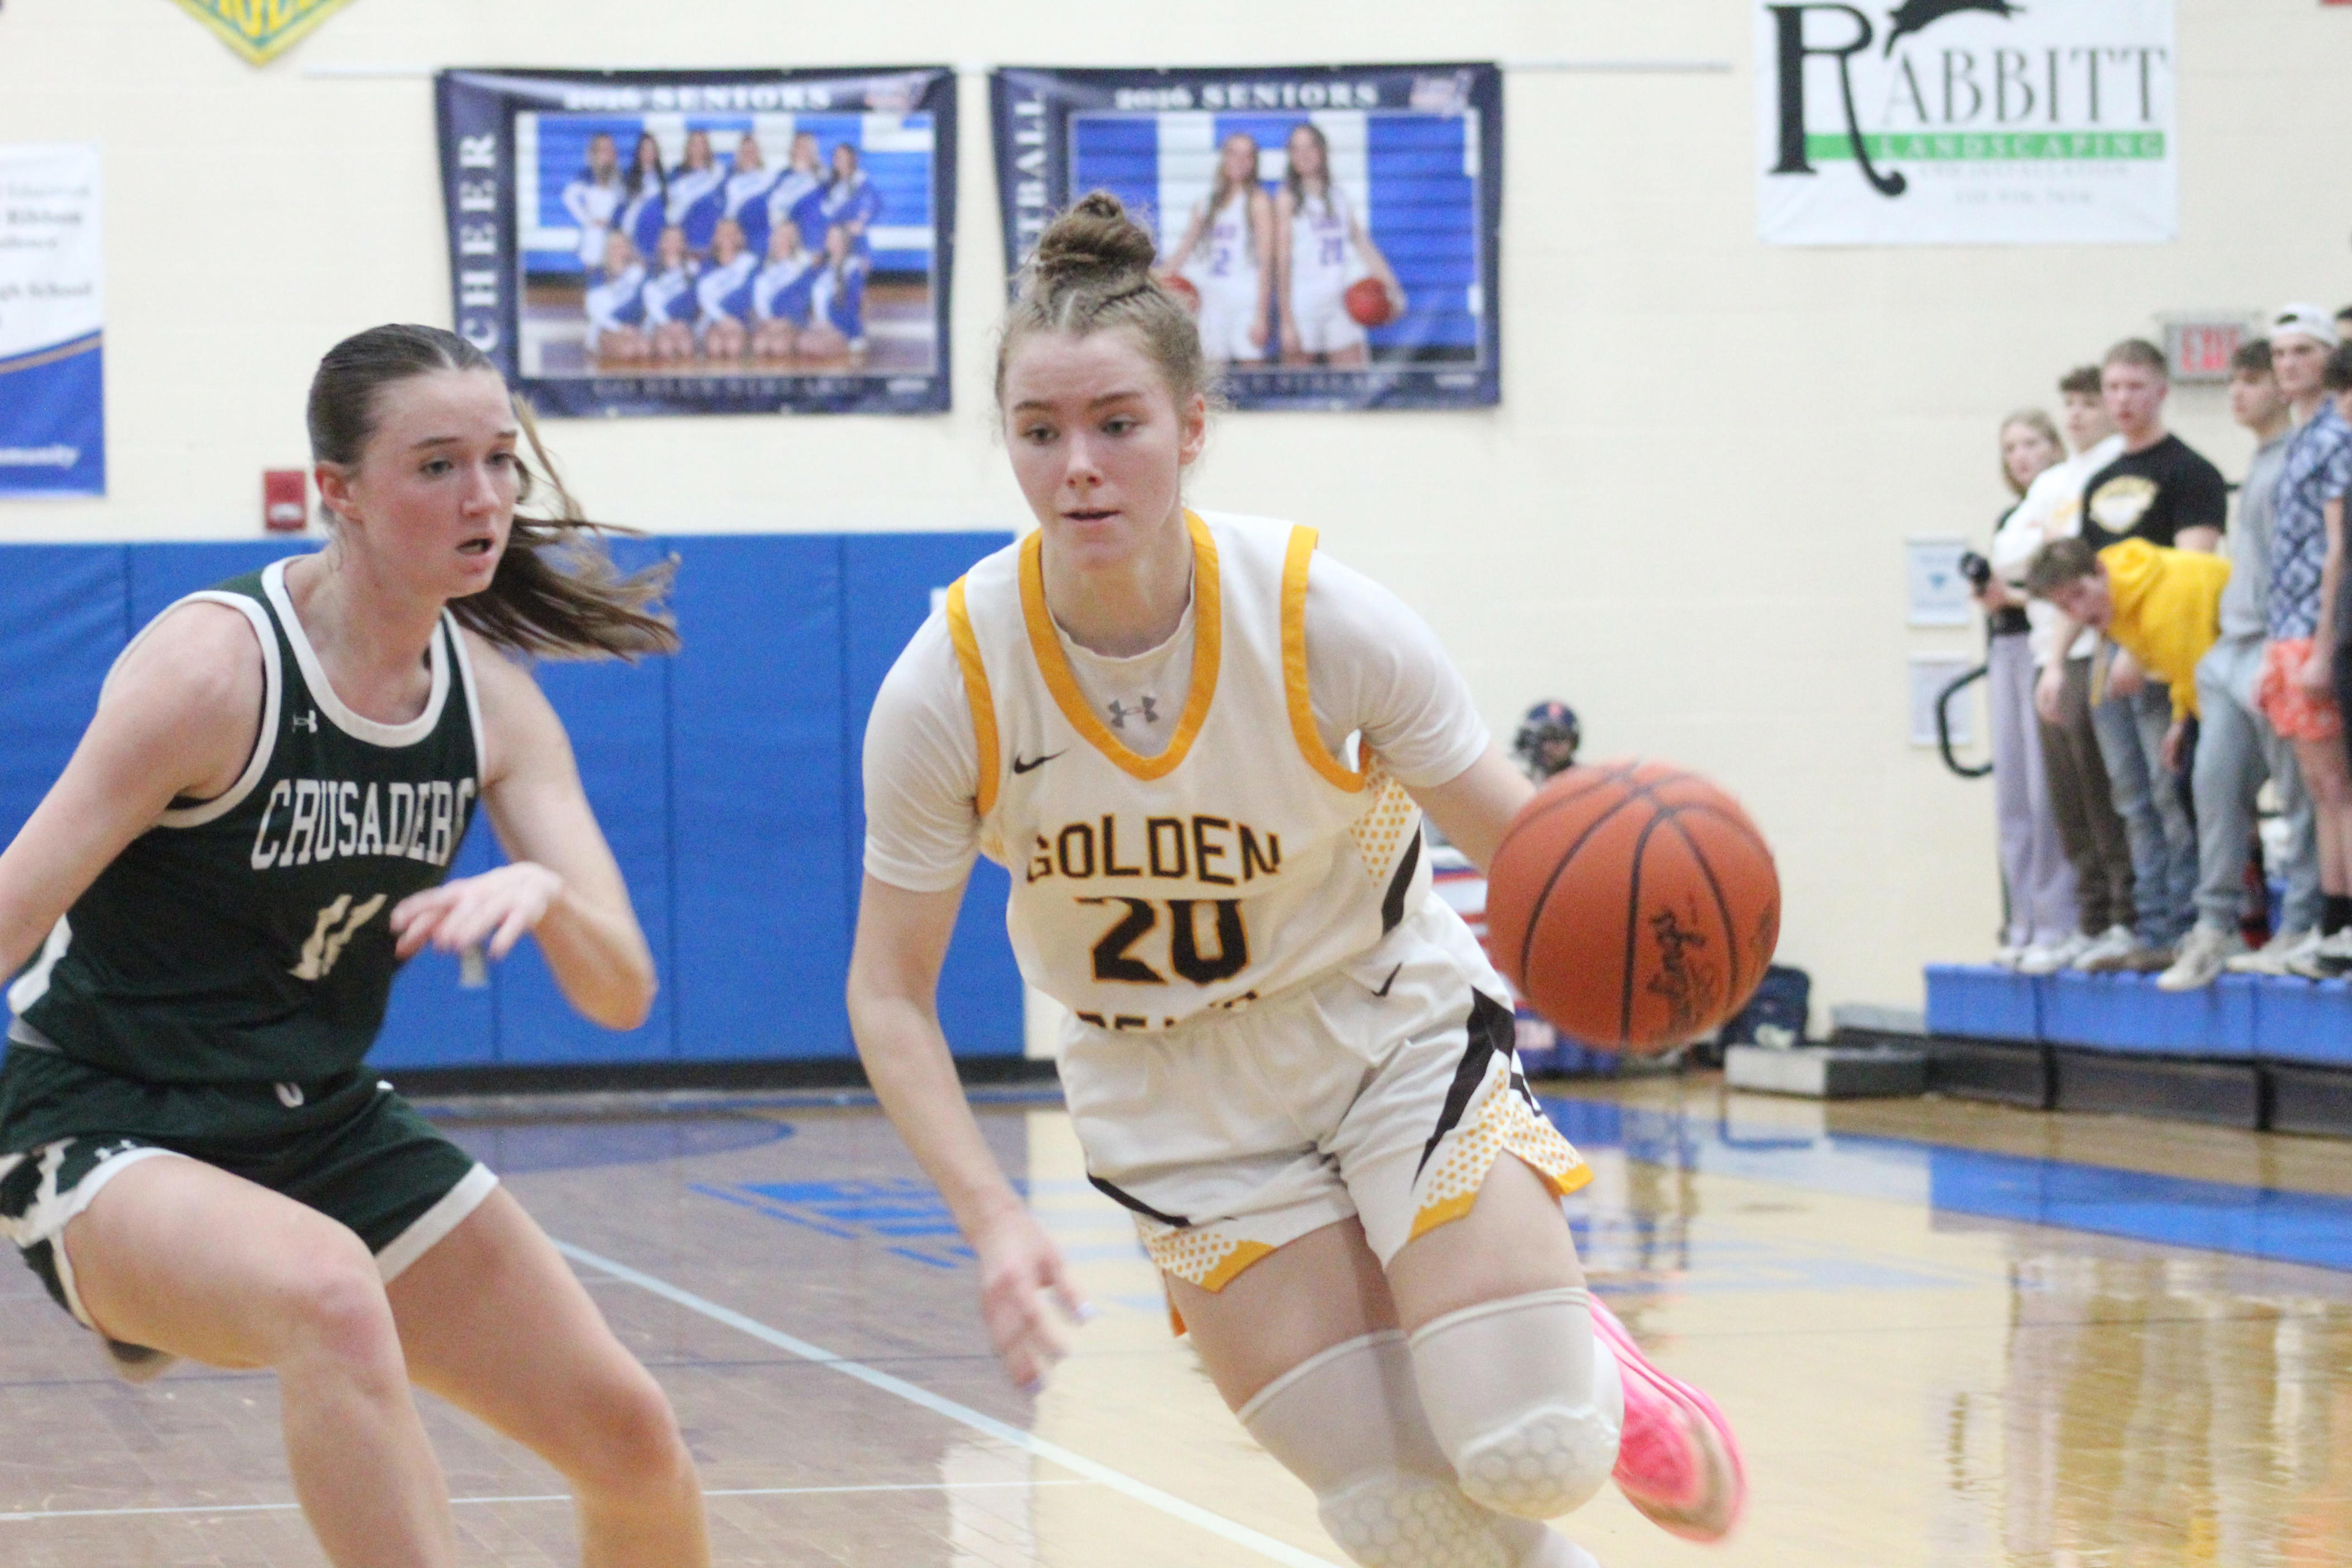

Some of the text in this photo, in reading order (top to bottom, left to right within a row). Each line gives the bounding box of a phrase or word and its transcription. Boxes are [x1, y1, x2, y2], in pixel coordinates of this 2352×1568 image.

[651, 84, 832, 110] SENIORS
[1202, 82, 1377, 108] SENIORS
[1765, 2, 2167, 196] RABBITT
[1879, 134, 2164, 159] LANDSCAPING
[459, 135, 499, 352] CHEER
[1027, 814, 1281, 886] GOLDEN
[1075, 896, 1251, 989] 20
